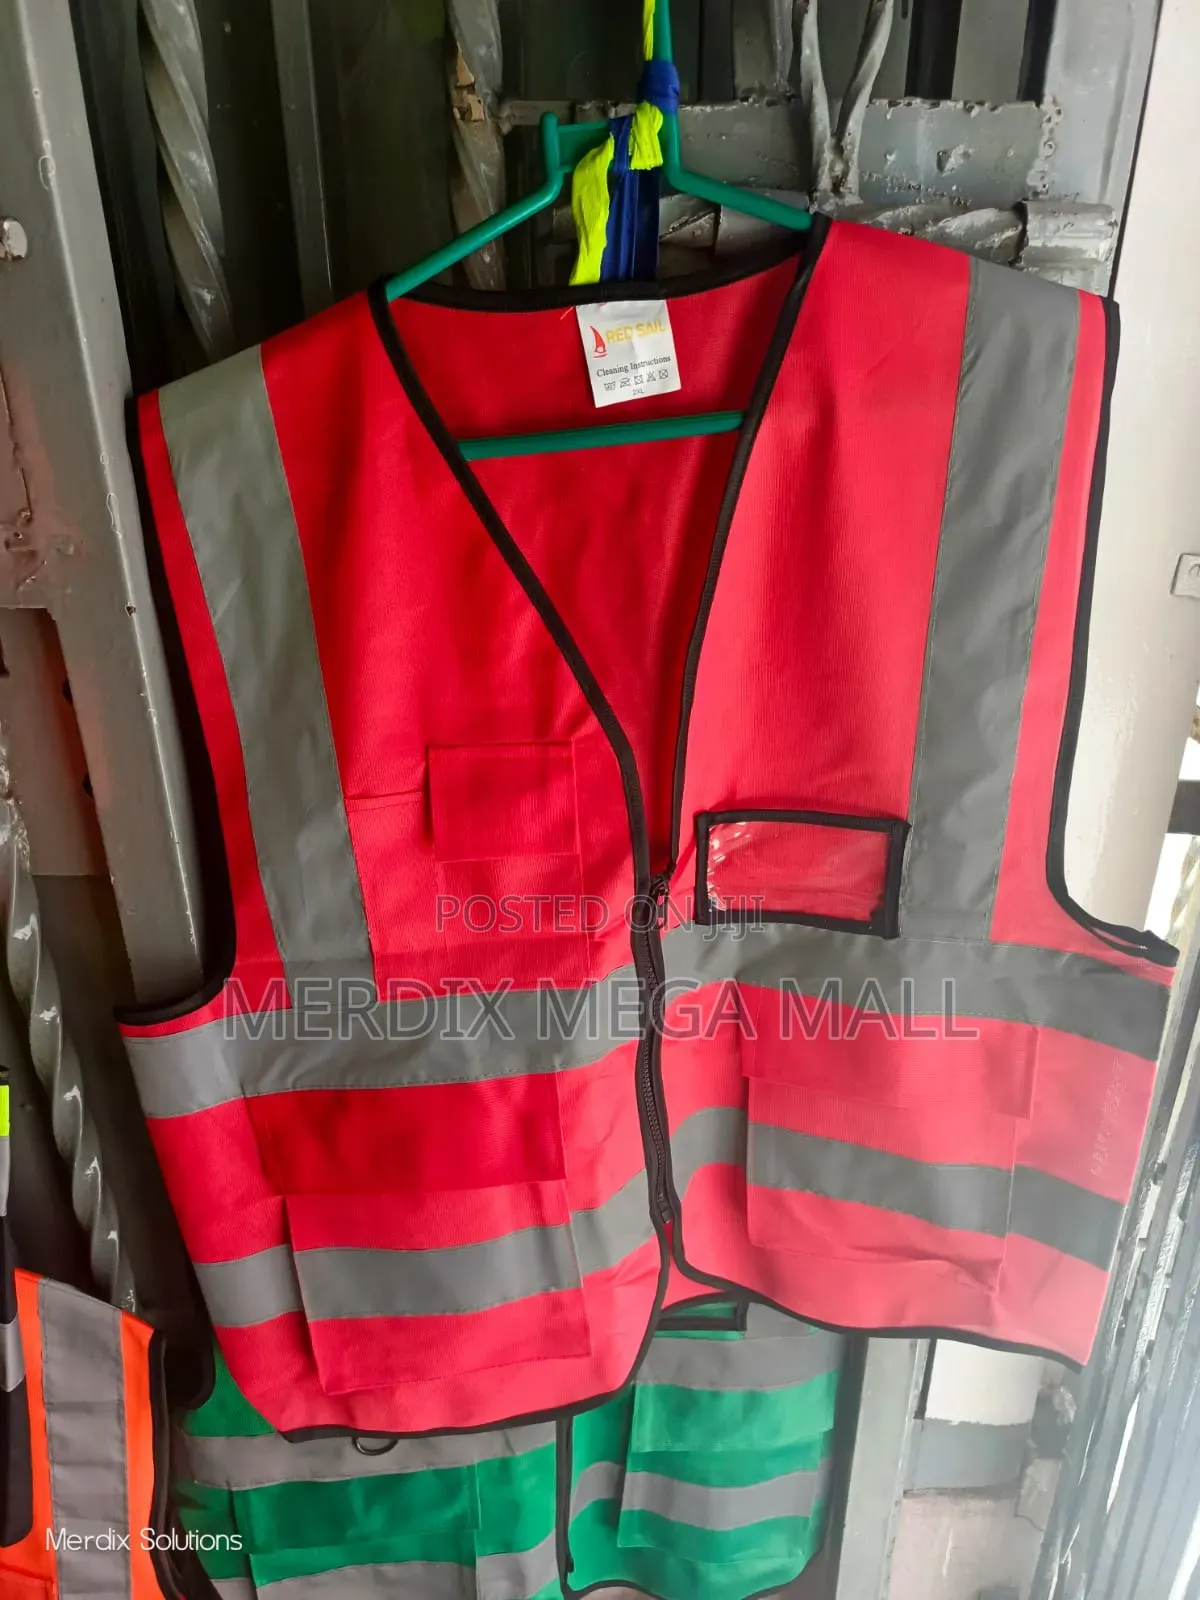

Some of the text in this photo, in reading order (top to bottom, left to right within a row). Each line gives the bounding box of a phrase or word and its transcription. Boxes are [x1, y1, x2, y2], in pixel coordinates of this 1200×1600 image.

[605, 320, 666, 344] RED SAIL
[596, 355, 671, 377] Cleaning Instructions
[632, 388, 644, 396] 2XL
